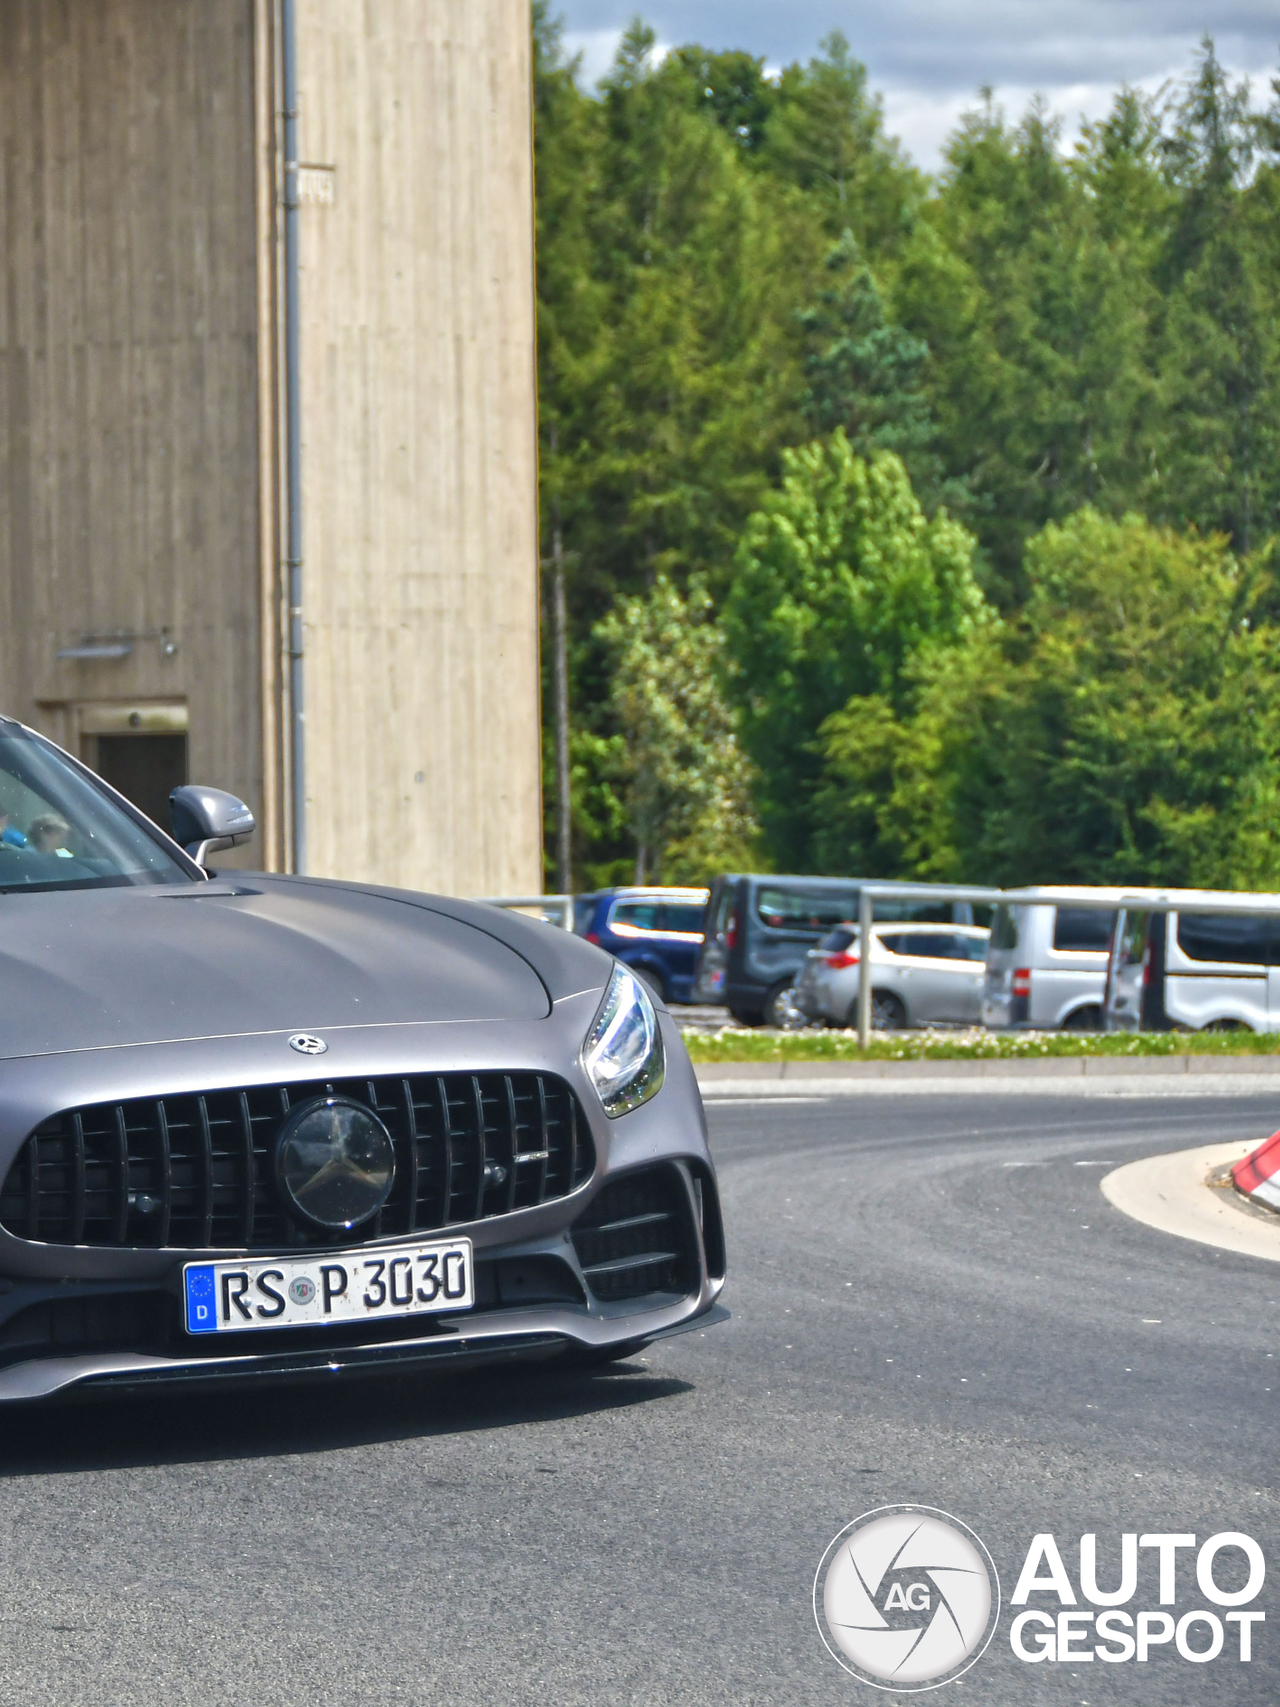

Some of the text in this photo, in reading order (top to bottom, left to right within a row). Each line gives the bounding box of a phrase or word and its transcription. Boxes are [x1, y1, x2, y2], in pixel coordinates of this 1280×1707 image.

[221, 1269, 286, 1321] RS
[320, 1264, 348, 1313] P
[363, 1251, 466, 1307] 3030
[196, 1305, 208, 1319] D
